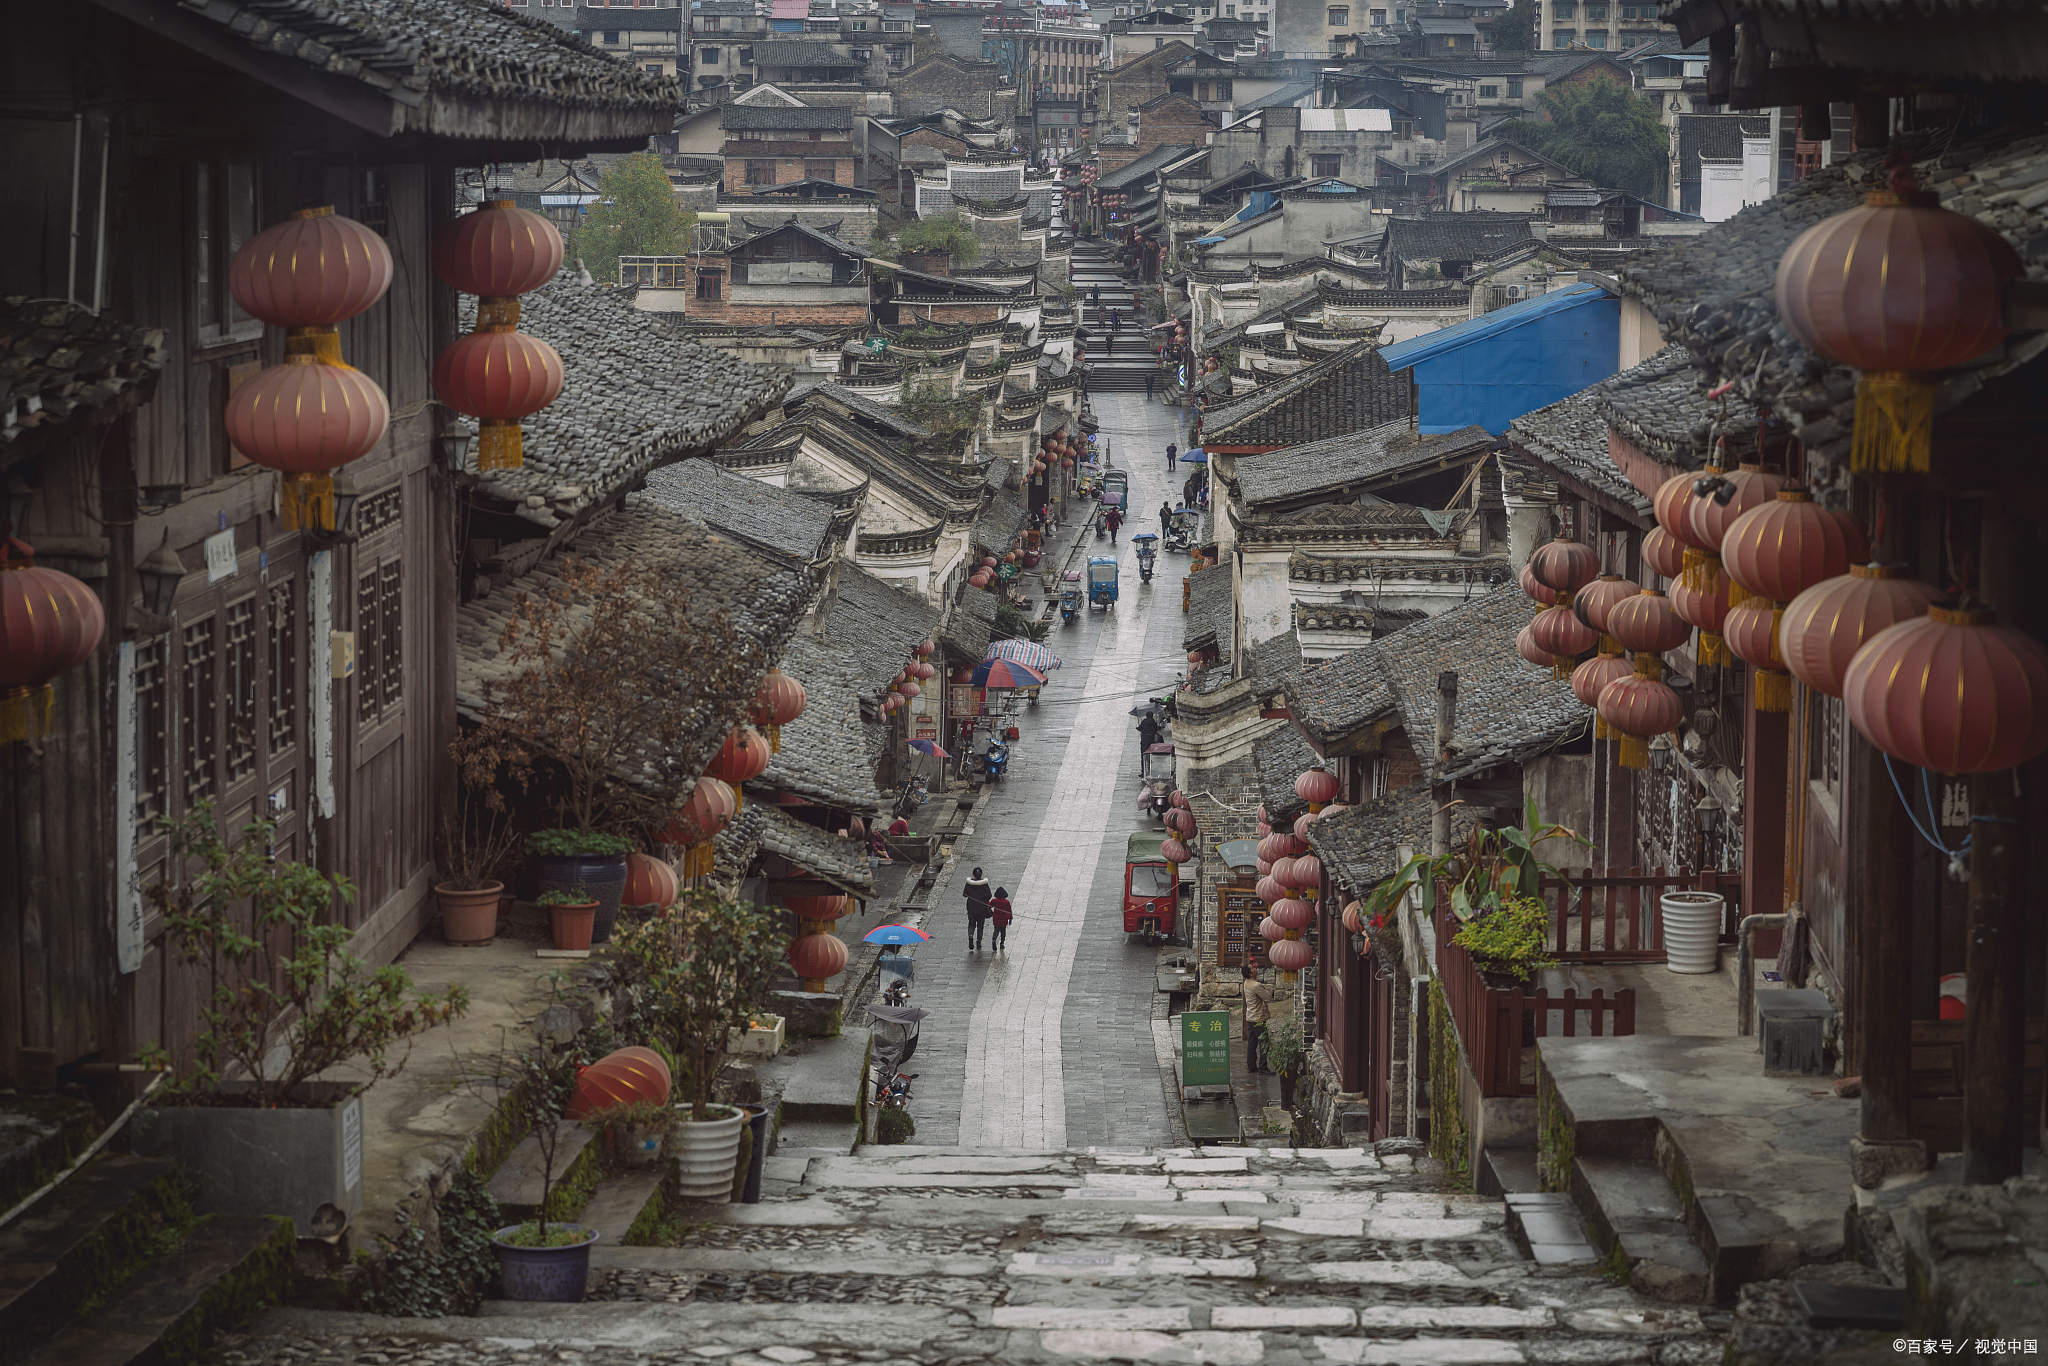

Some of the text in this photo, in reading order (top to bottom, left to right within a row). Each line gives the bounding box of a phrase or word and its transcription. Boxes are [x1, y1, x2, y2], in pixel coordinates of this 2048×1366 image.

[872, 338, 884, 352] 茶
[998, 564, 1012, 578] 茶
[1188, 1020, 1223, 1033] 专治
[1209, 1039, 1226, 1048] 心脏病
[1186, 1050, 1204, 1059] 妇科病
